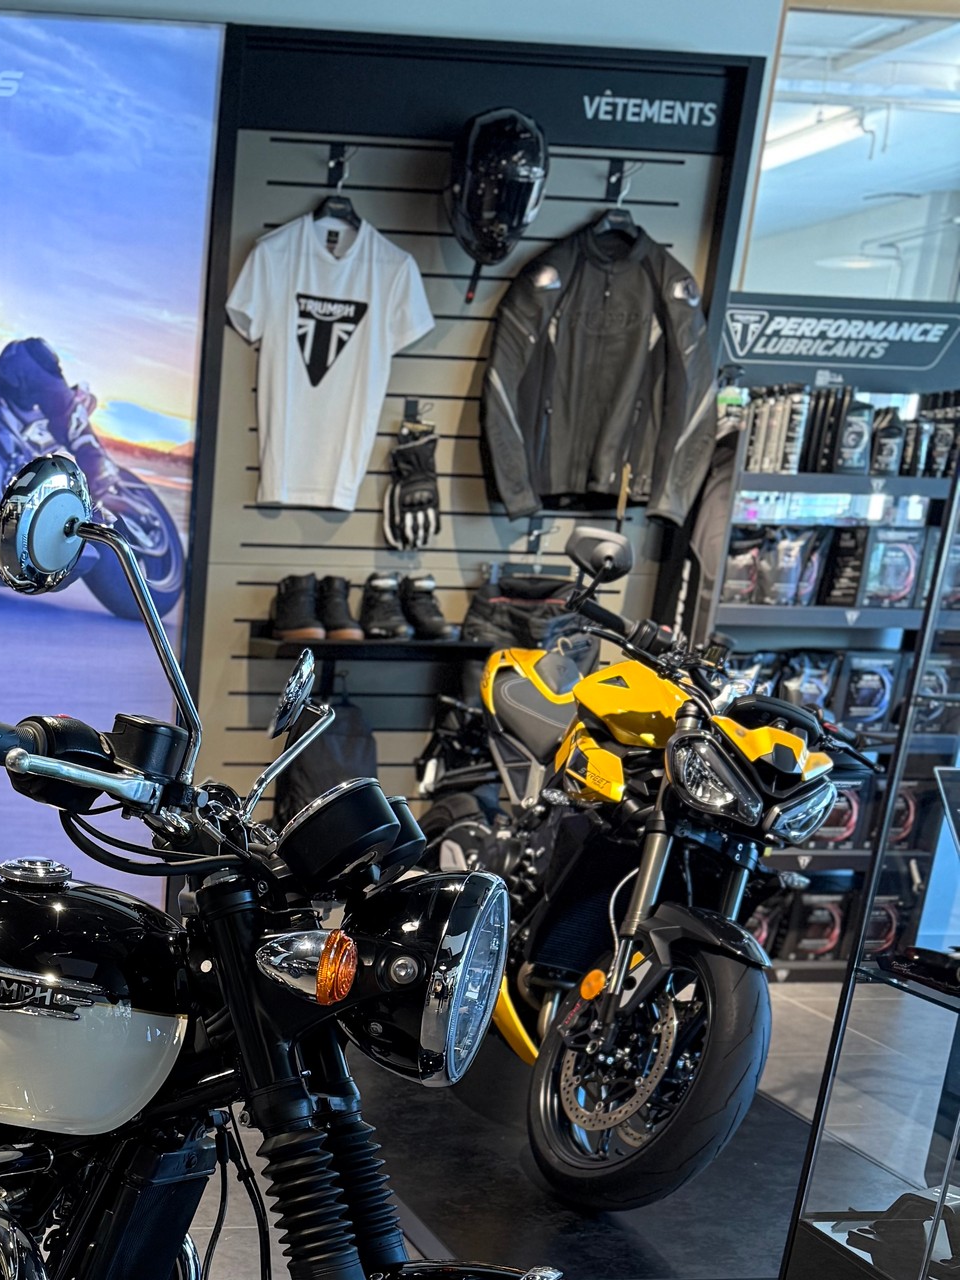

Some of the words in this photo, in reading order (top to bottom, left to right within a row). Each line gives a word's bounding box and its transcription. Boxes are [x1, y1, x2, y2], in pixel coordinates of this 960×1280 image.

[583, 88, 717, 127] VÊTEMENTS
[299, 299, 355, 321] TRIUMPH
[764, 316, 949, 343] PERFORMANCE
[753, 336, 888, 358] LUBRICANTS
